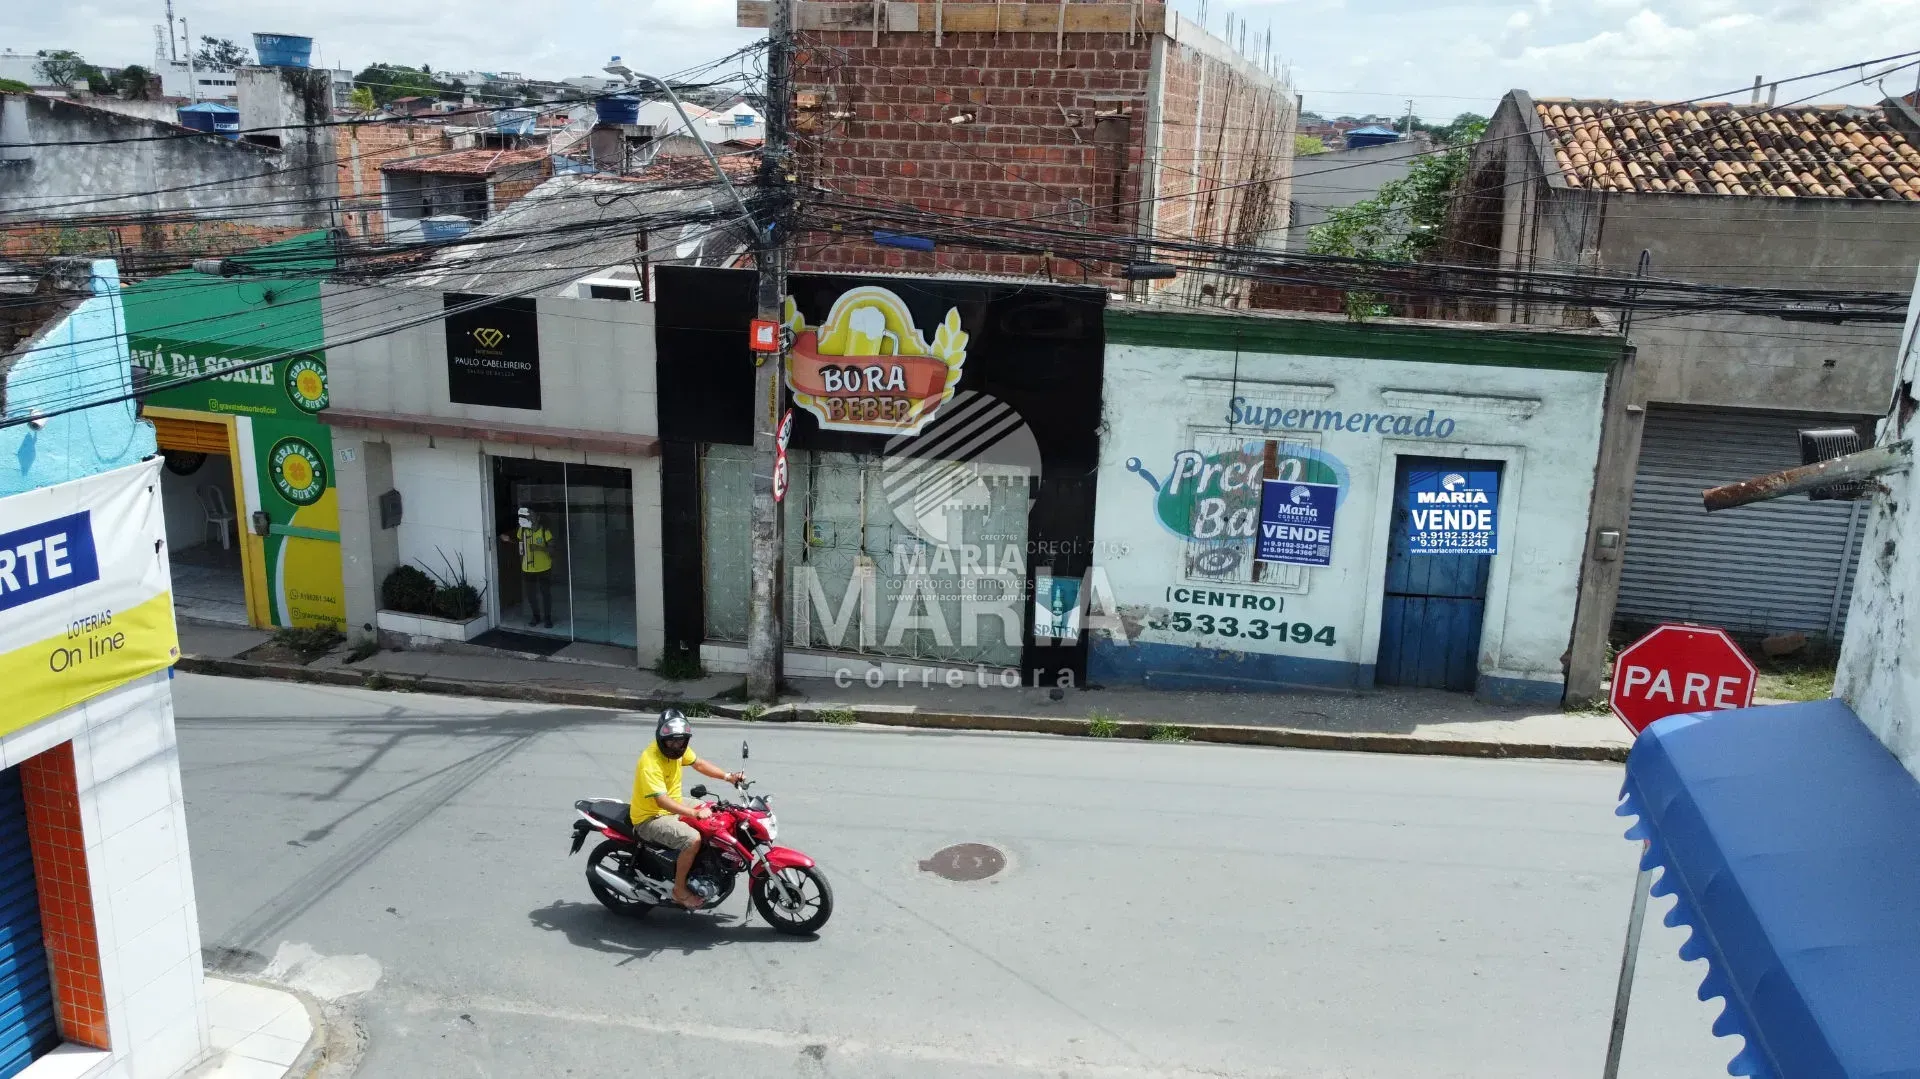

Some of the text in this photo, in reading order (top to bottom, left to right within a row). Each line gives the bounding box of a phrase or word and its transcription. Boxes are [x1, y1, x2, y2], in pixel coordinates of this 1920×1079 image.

[171, 353, 200, 377] DA
[204, 356, 275, 385] SORTE
[290, 361, 327, 381] GRAVATA
[455, 357, 532, 371] PAULO CABELEIREIRO
[819, 364, 906, 392] BORA
[294, 392, 328, 409] DA SORTE
[827, 397, 912, 422] BEBER
[1224, 396, 1456, 438] Supermercado
[275, 444, 319, 468] GRAVATA
[279, 479, 319, 499] DA SORTE
[1417, 492, 1489, 504] MARIA
[1194, 497, 1258, 539] Ba
[1278, 504, 1318, 517] Maria
[1411, 509, 1492, 530] VENDE
[1262, 524, 1330, 543] VENDE
[1420, 531, 1489, 539] 9.9192.5342
[1420, 539, 1488, 547] 9.9714.2245
[1166, 586, 1284, 613] (CENTRO)
[66, 609, 112, 640] LOTERIAS
[50, 631, 125, 673] On line
[1622, 665, 1742, 710] PARE
